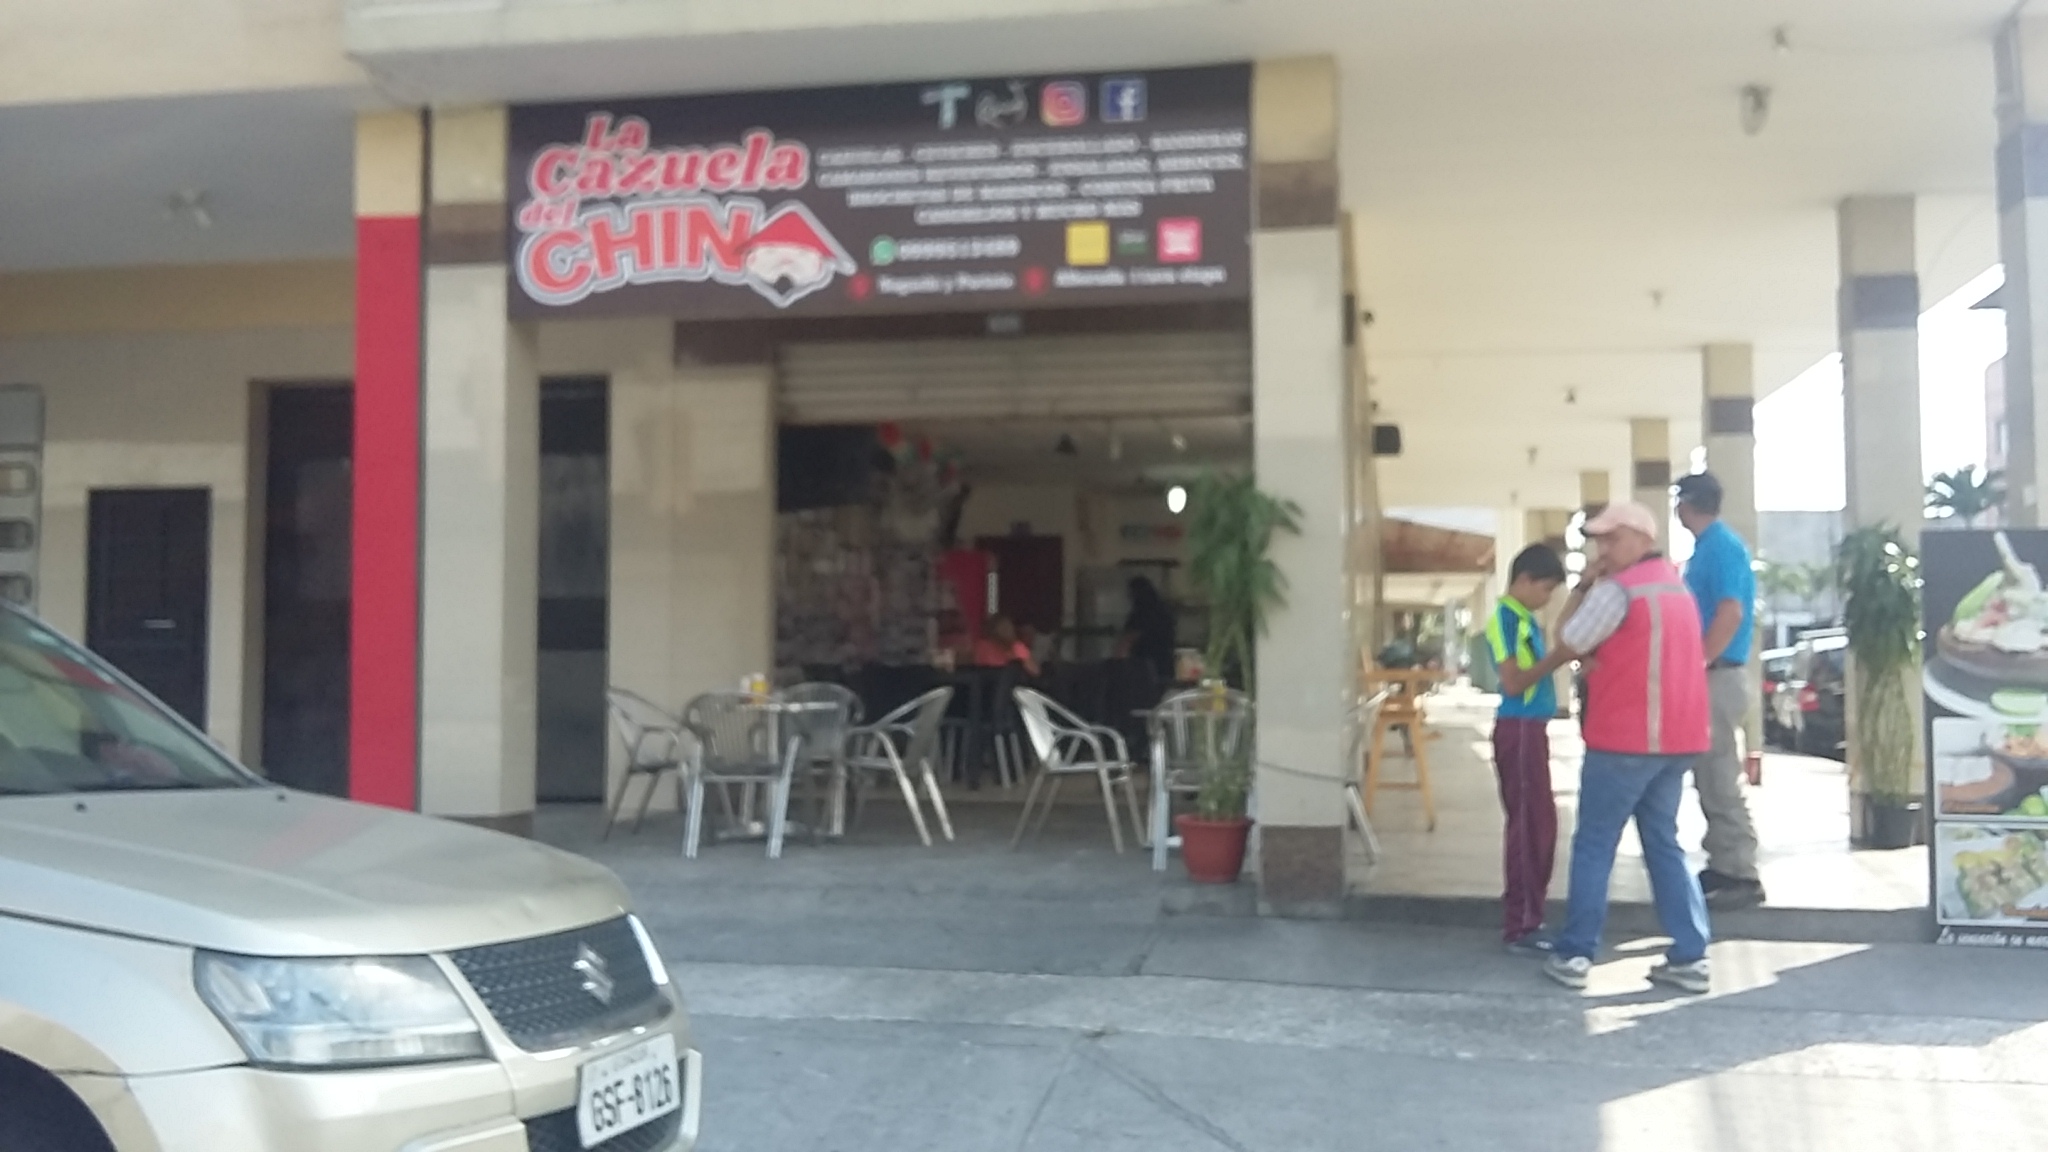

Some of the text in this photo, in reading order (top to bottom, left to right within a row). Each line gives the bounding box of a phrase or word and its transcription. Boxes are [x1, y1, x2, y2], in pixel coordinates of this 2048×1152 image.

[584, 114, 649, 150] La
[530, 131, 809, 197] Cazuela
[517, 198, 578, 227] del
[592, 1063, 673, 1132] GSF-8126
